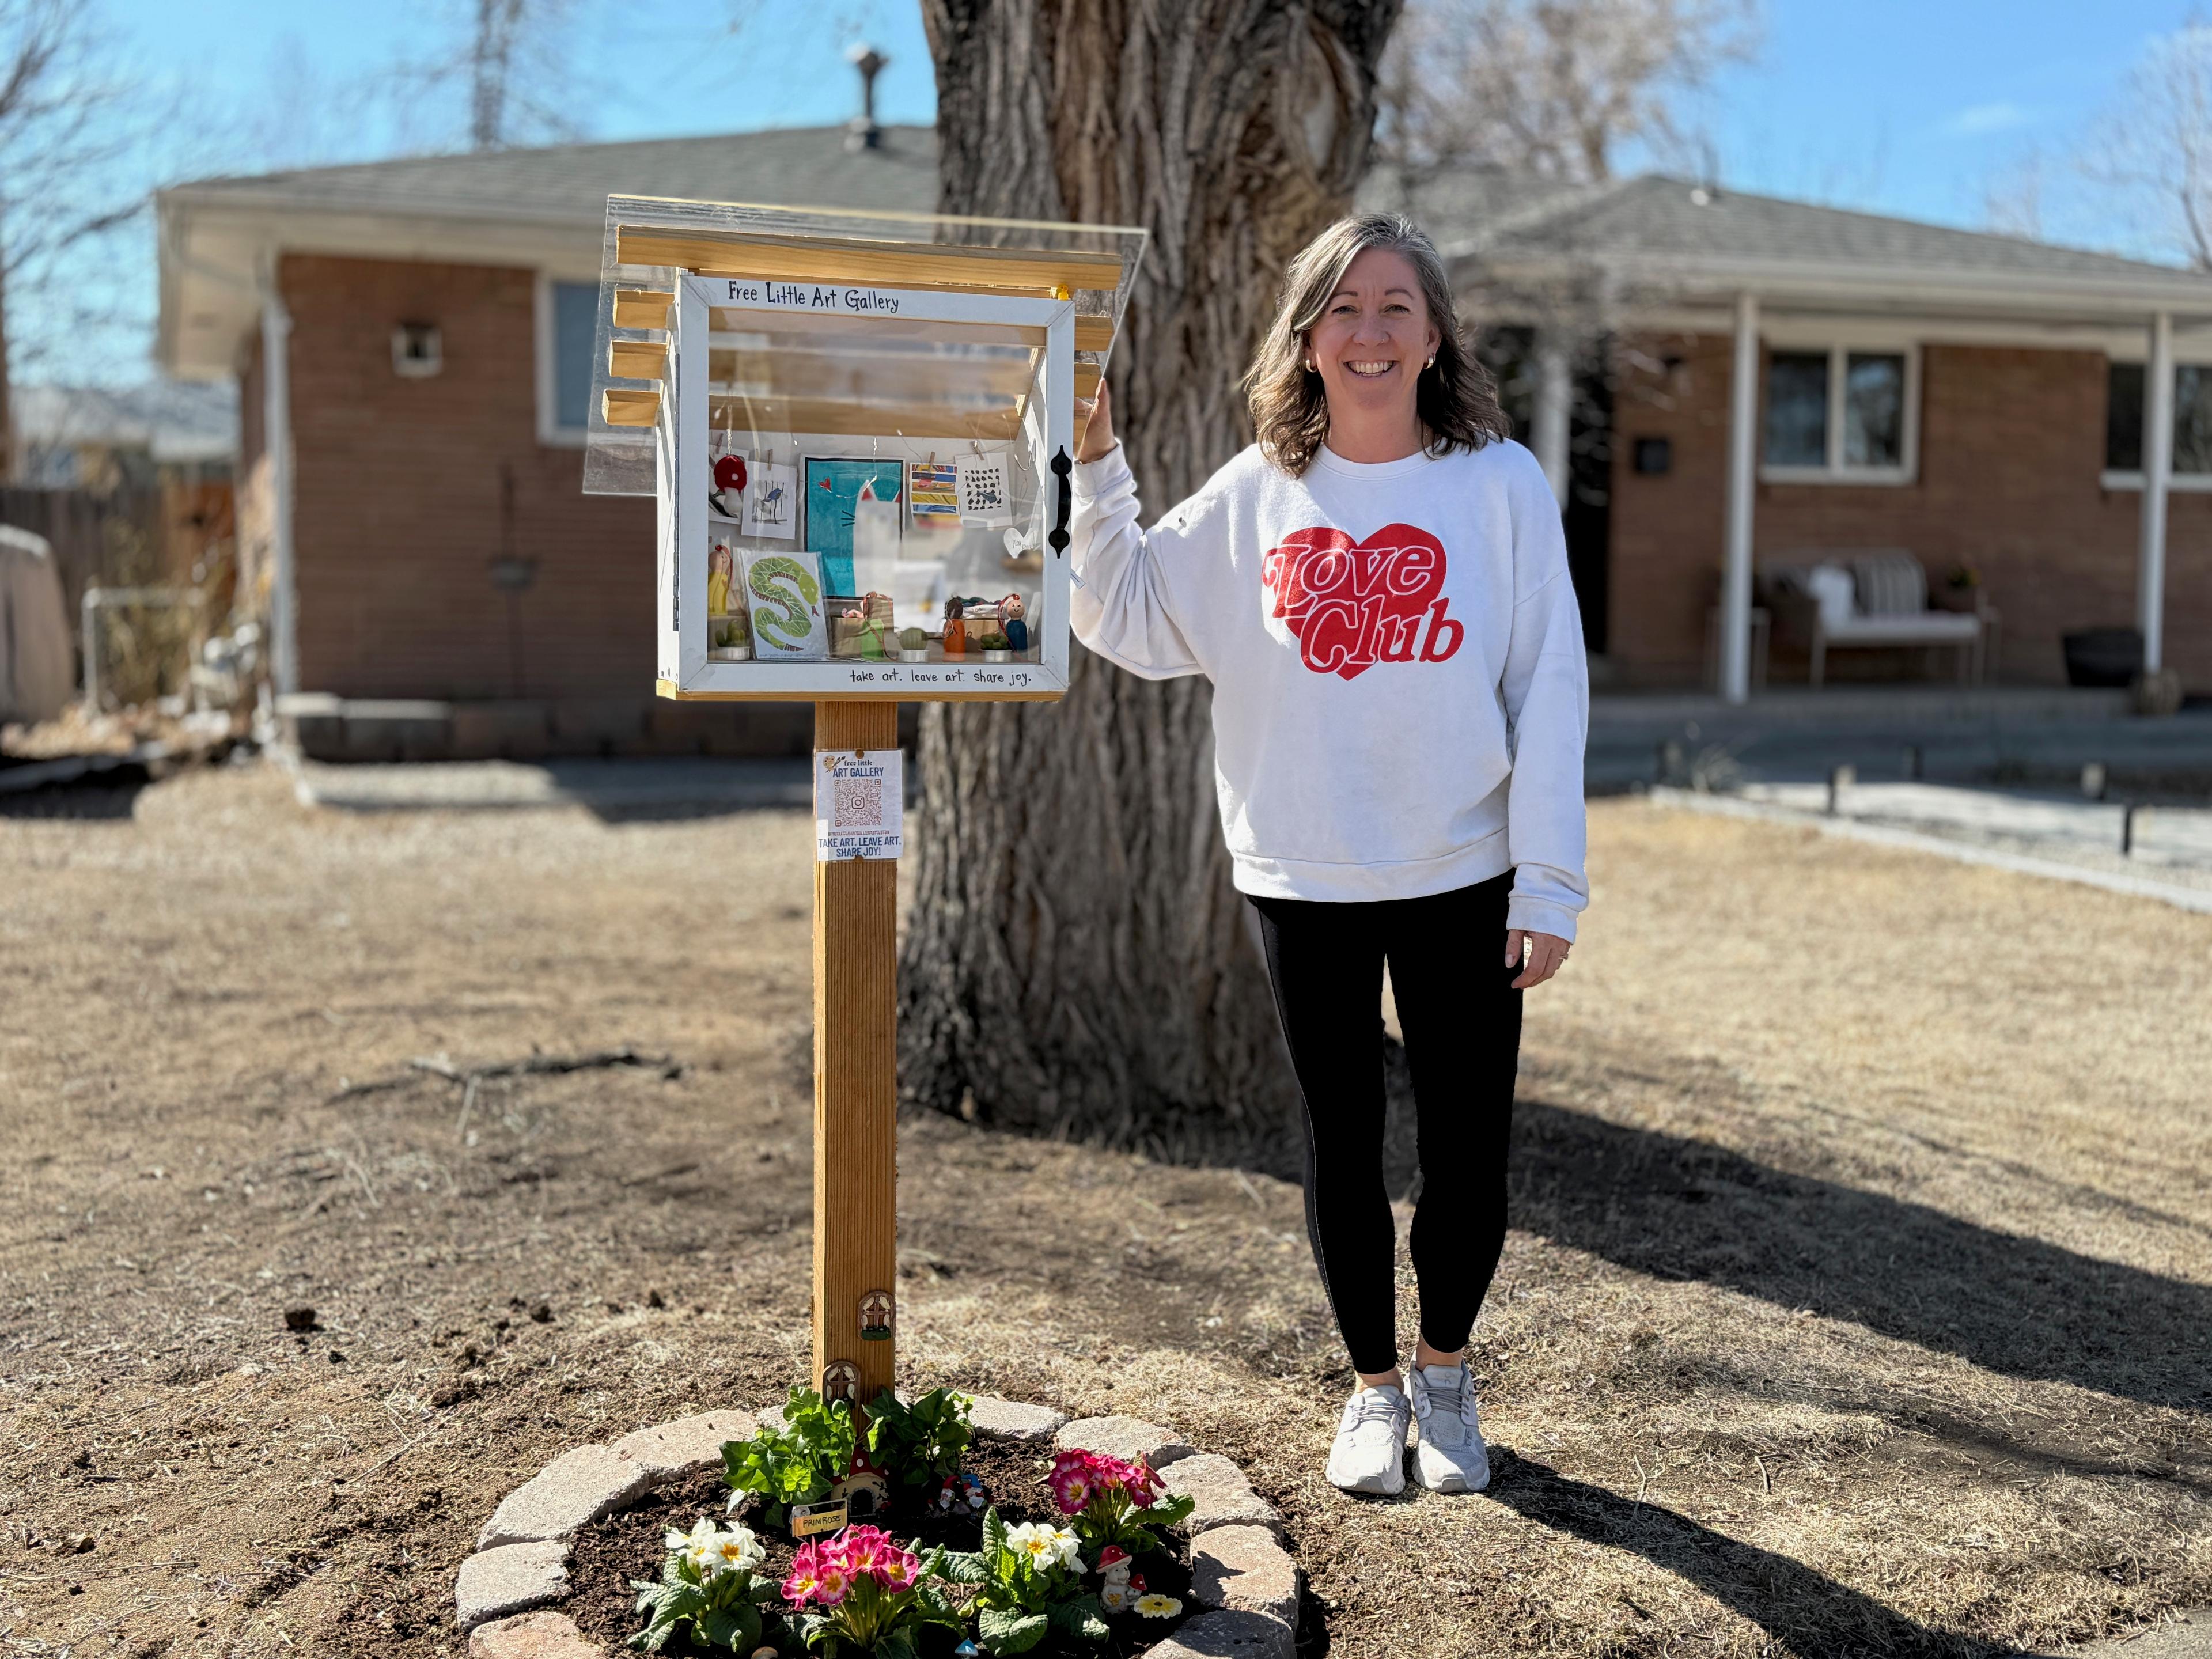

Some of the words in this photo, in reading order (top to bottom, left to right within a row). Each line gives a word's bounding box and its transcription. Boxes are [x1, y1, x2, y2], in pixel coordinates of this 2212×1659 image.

[729, 281, 757, 301] Free
[766, 282, 805, 305] Little
[812, 287, 837, 307] Art
[845, 289, 899, 313] Gallery
[1262, 544, 1435, 619] Love
[1300, 594, 1464, 673] Club
[849, 669, 874, 683] take
[882, 668, 902, 681] art.
[911, 669, 938, 683] leave
[974, 669, 1004, 683] share
[1009, 672, 1032, 687] joy.
[833, 768, 848, 777] ART
[850, 767, 884, 777] GALLERY
[819, 838, 838, 847] TAKE
[840, 838, 857, 846] ART.
[859, 836, 882, 846] LEAVE
[884, 836, 901, 846] ART.
[836, 848, 861, 857] SHARE
[863, 847, 881, 856] JOY!
[803, 1515, 841, 1528] PRIMROSE
